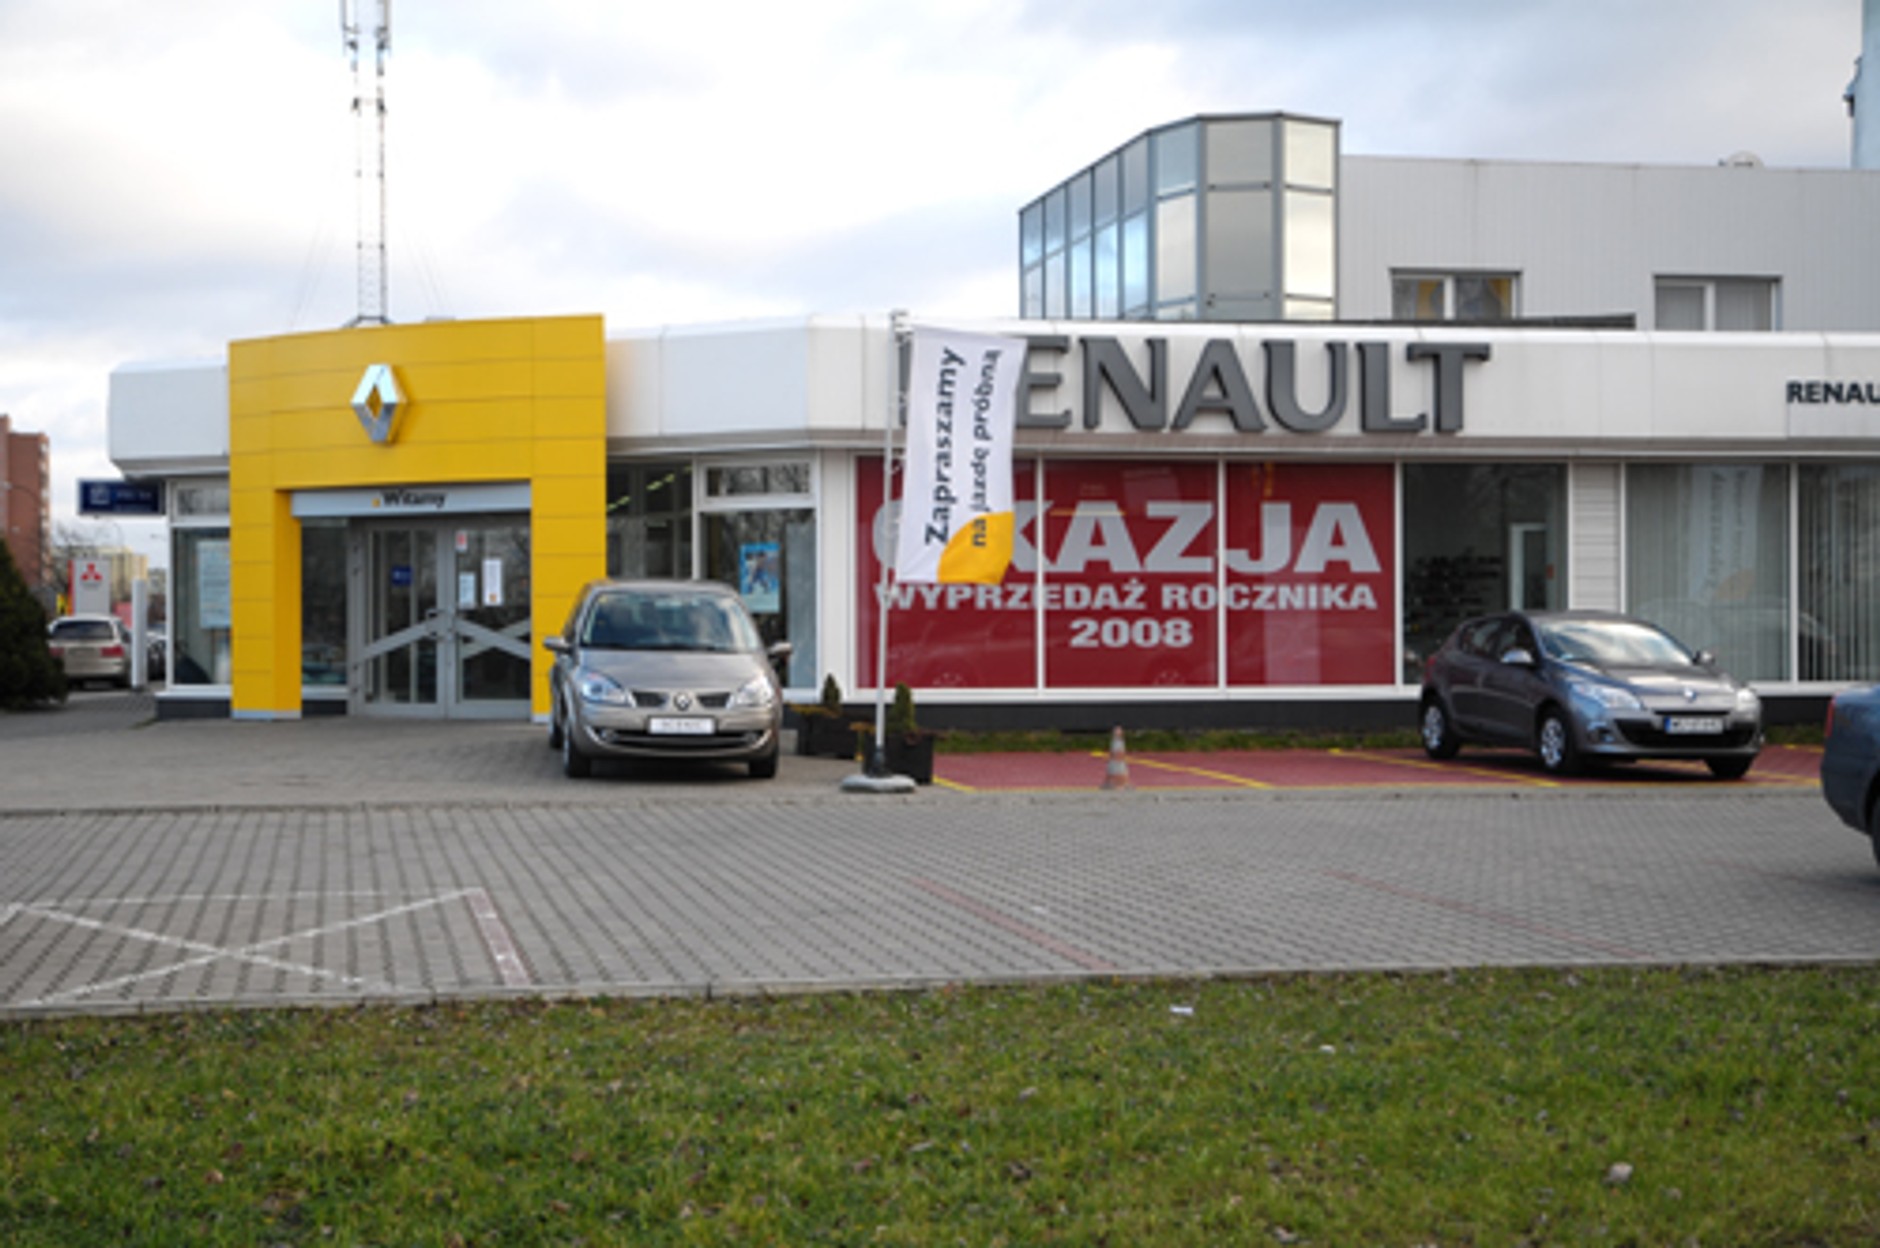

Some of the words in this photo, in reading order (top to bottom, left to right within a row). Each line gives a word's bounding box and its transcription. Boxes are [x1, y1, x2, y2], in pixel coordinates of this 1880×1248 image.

[898, 334, 1491, 433] ENAULT
[925, 346, 967, 546] Zapraszamy
[973, 518, 987, 547] na
[1161, 584, 1377, 610] ROCZNIKA
[1069, 617, 1193, 648] 2008
